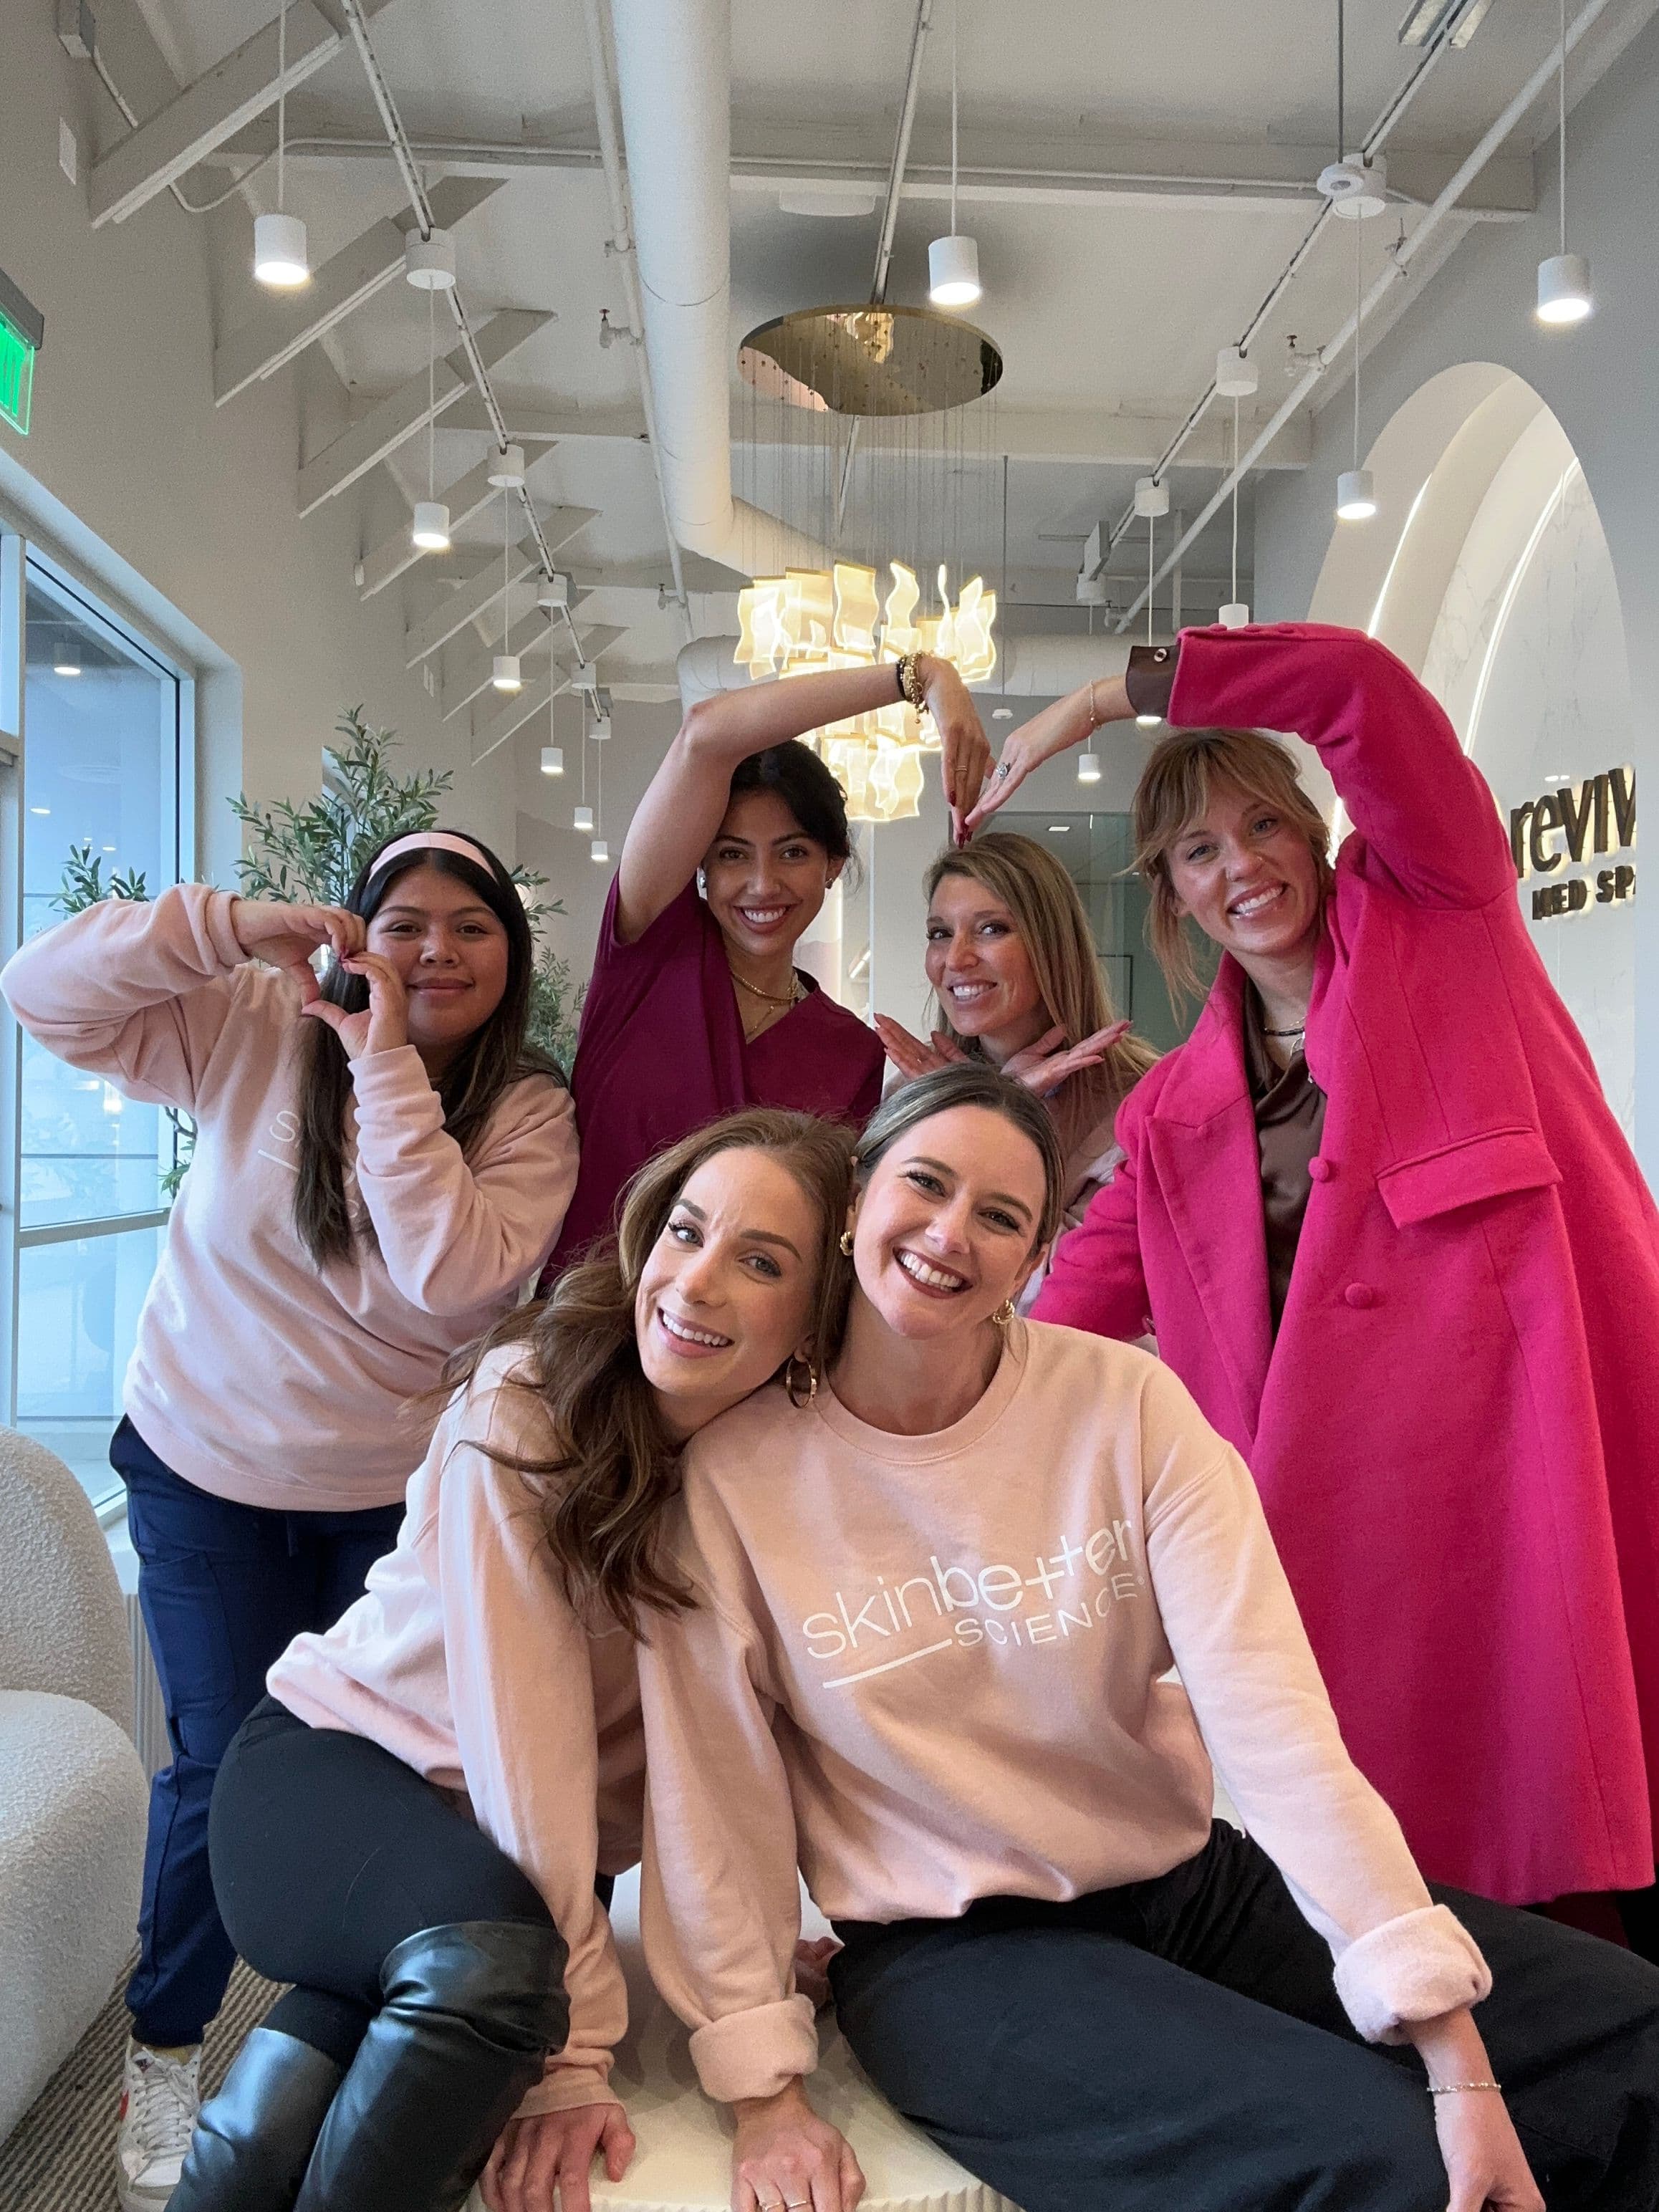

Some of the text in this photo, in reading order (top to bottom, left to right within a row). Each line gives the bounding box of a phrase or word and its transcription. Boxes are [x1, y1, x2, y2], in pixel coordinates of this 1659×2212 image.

[1532, 865, 1635, 920] MED SP
[802, 1519, 1132, 1659] skinbetter
